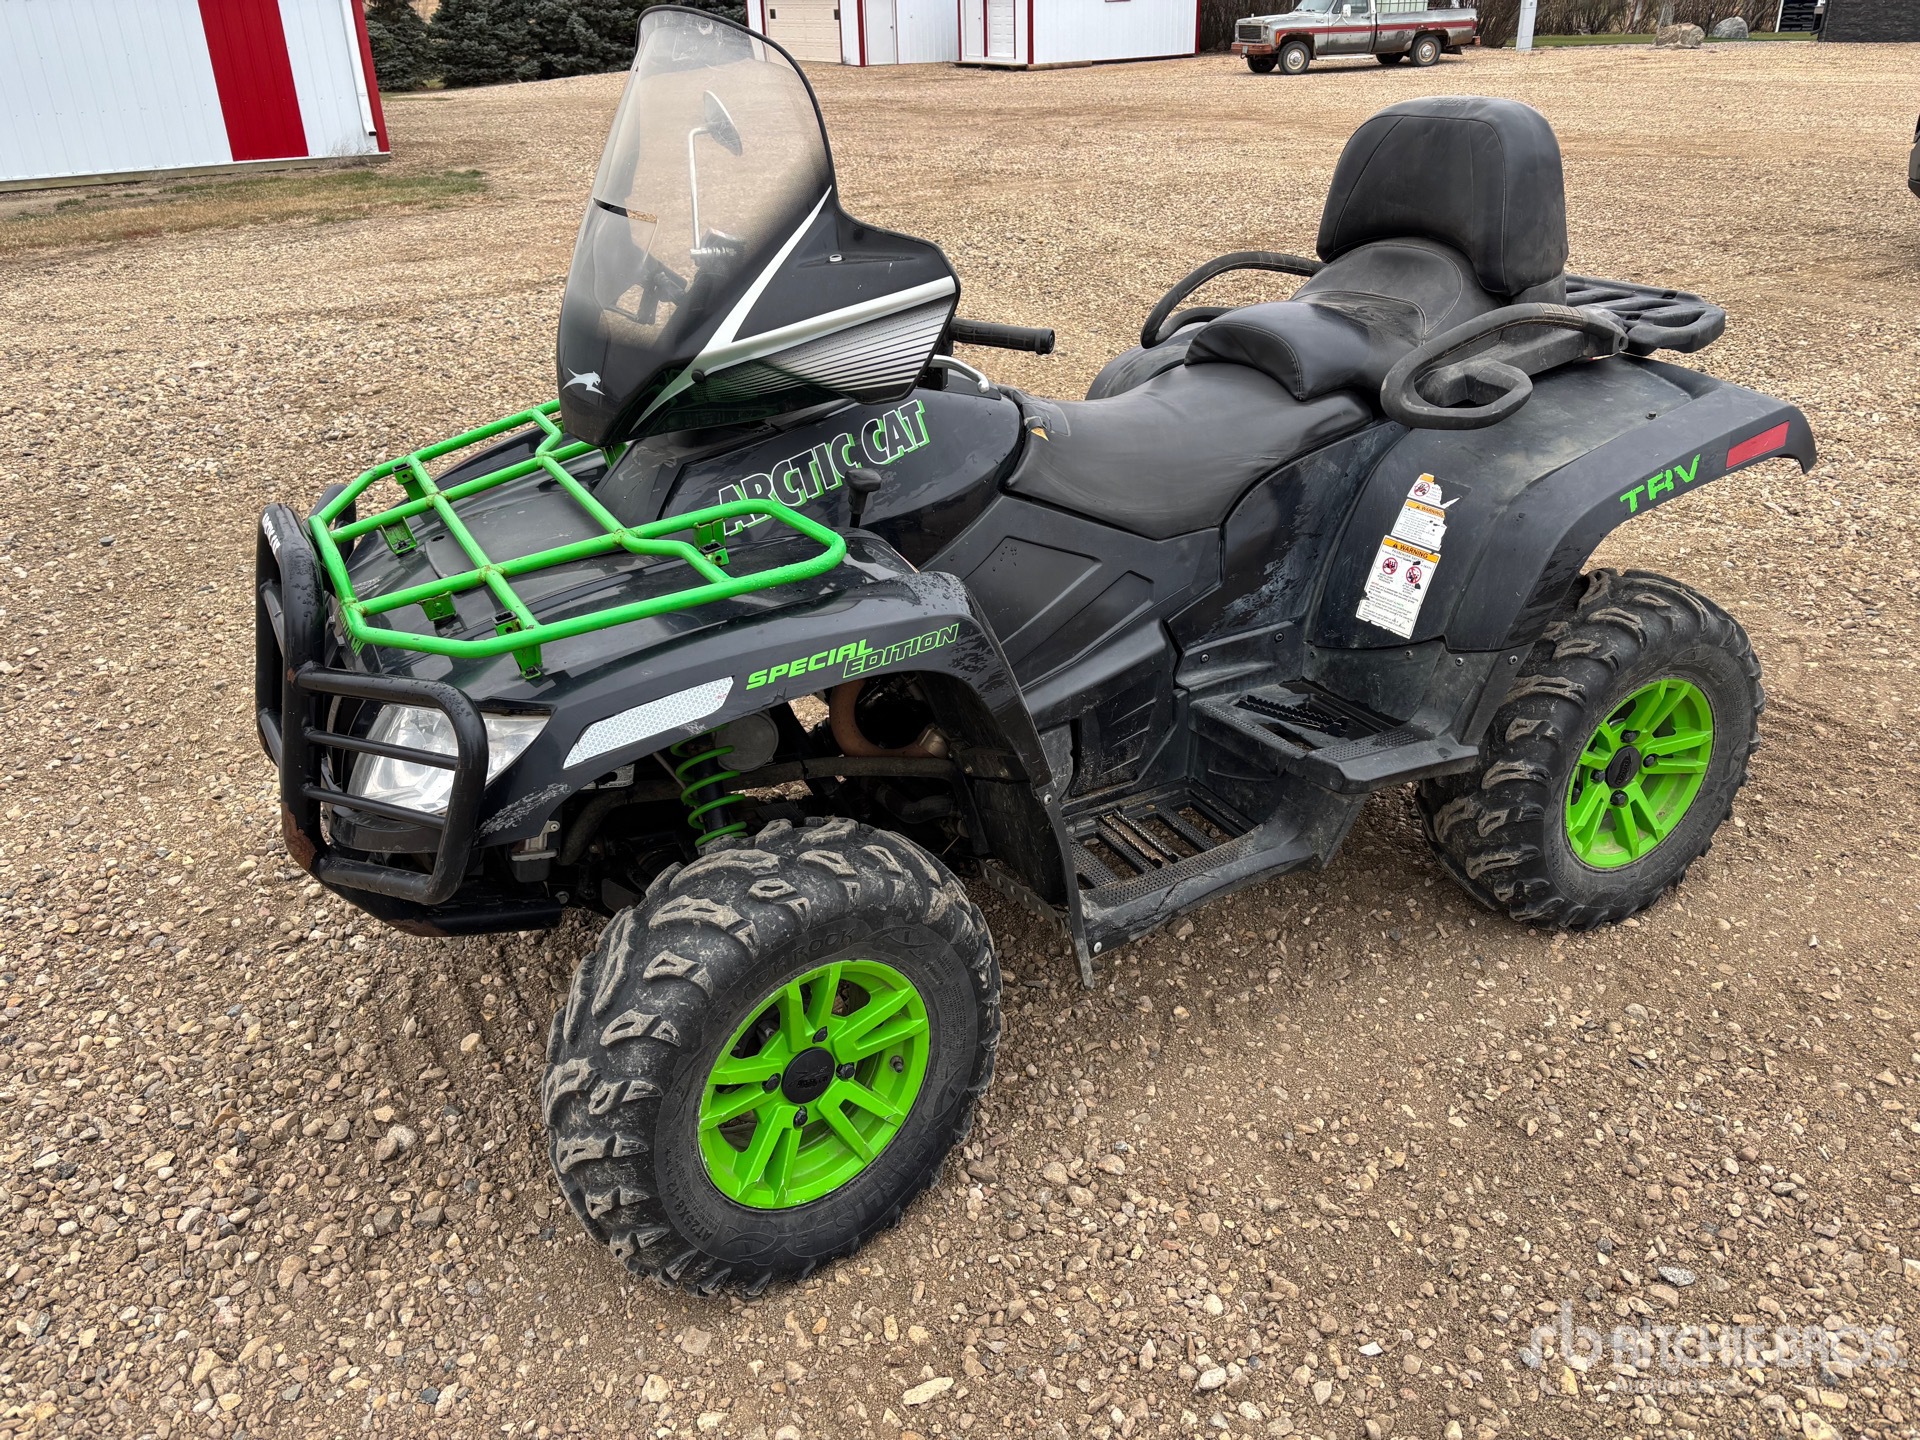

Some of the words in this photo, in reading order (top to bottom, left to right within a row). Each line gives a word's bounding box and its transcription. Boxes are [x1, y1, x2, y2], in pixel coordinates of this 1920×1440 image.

[718, 432, 862, 536] ARCTIC
[861, 399, 930, 465] CAT
[1619, 453, 1700, 513] TRV
[1400, 544, 1429, 559] WARNING
[745, 639, 874, 690] SPECIAL
[842, 623, 961, 679] EDITION
